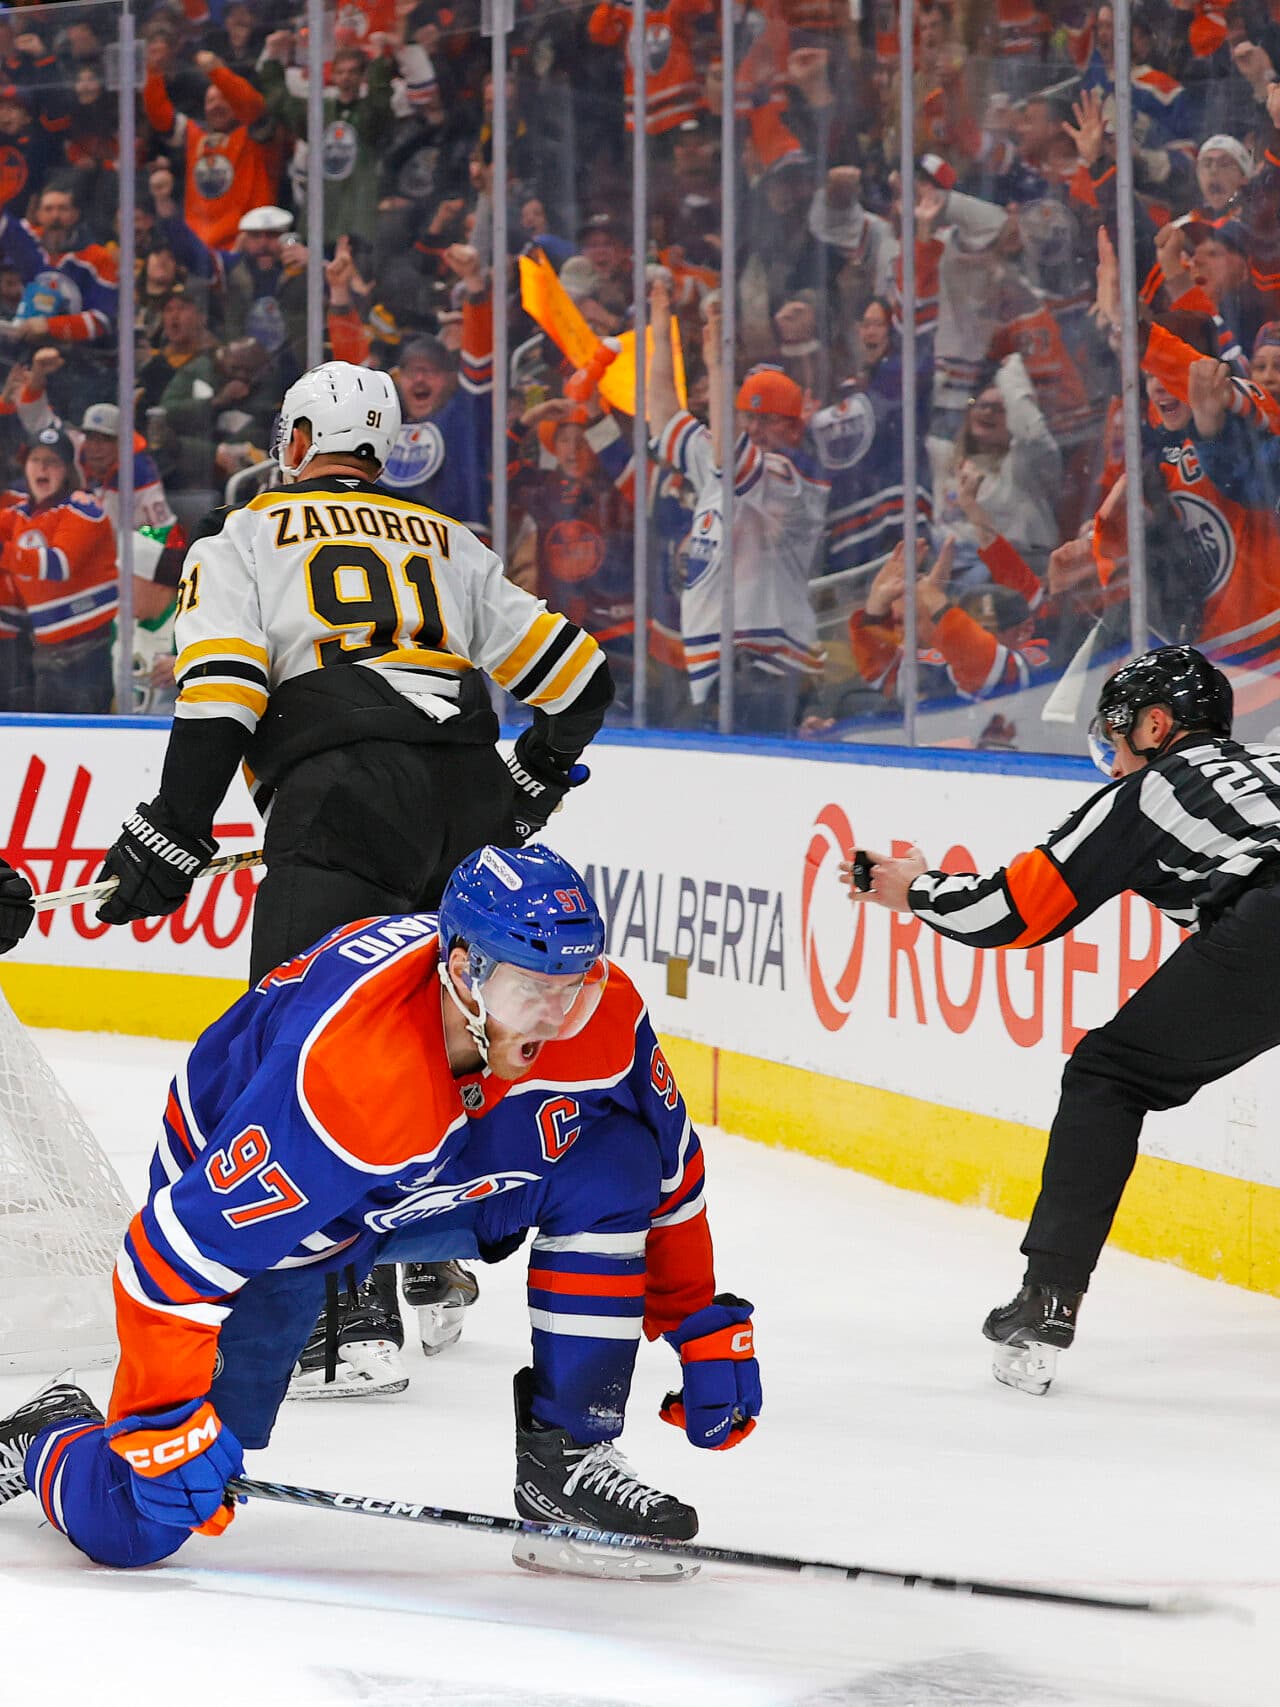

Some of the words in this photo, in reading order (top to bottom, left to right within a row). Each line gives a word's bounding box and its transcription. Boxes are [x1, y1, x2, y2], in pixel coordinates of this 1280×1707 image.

[365, 410, 382, 429] 91
[269, 505, 451, 560] ZADOROV
[304, 540, 449, 668] 91
[553, 888, 587, 913] 97
[560, 943, 595, 955] CCM
[888, 839, 1192, 1055] ROGER
[535, 1095, 581, 1163] C
[205, 1124, 309, 1229] 97
[124, 1415, 218, 1468] CCM
[704, 1416, 730, 1438] CCM
[333, 1494, 426, 1519] CCM
[523, 1480, 576, 1521] CCM
